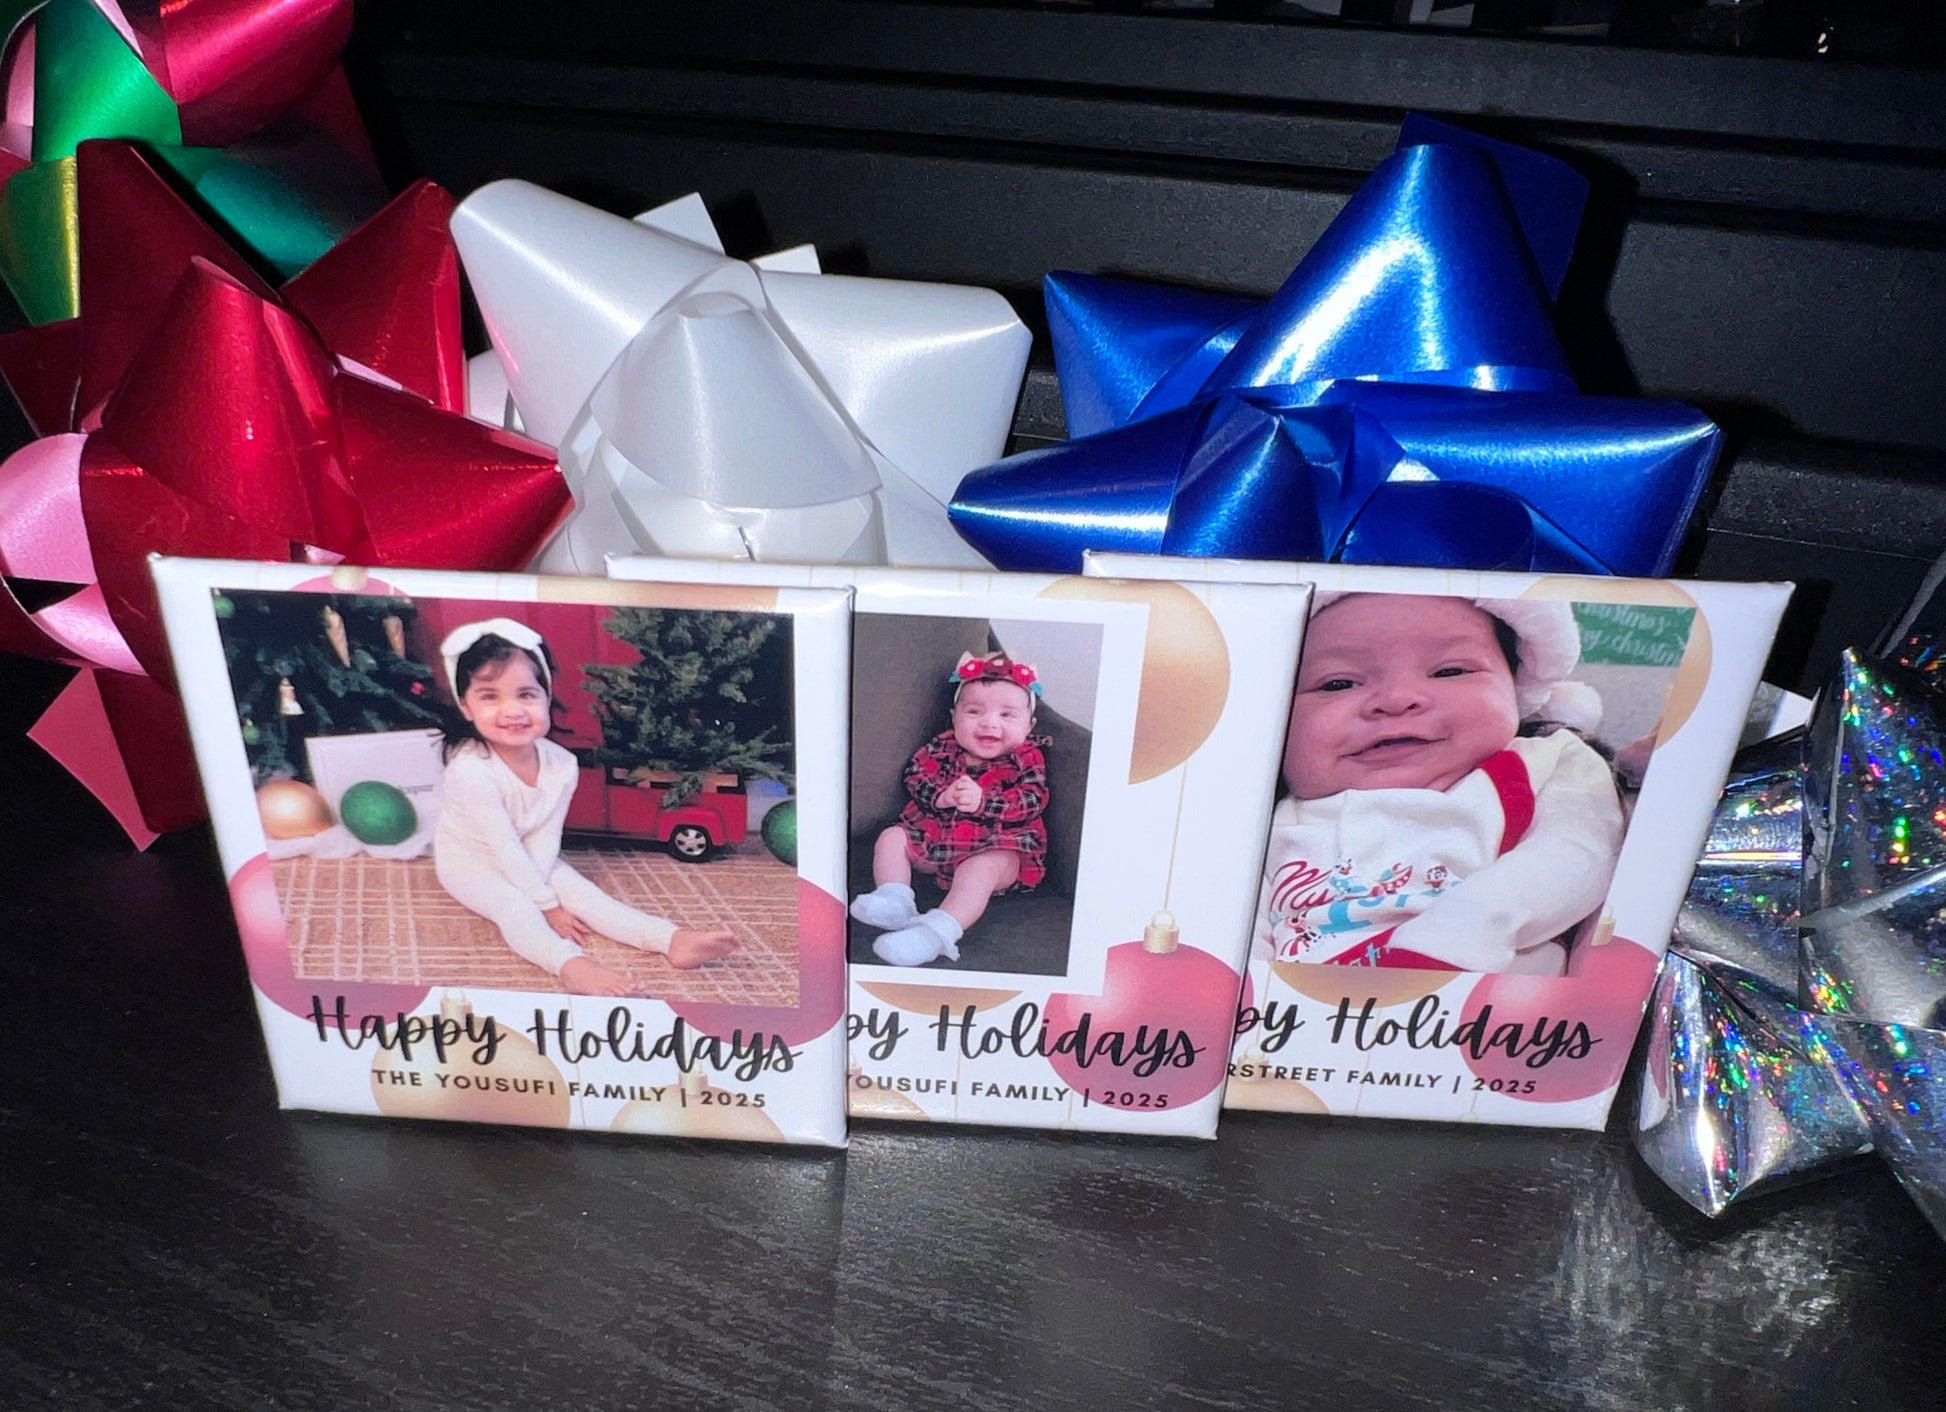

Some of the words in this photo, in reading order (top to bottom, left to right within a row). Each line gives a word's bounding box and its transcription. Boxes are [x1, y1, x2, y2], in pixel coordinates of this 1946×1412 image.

[307, 994, 506, 1064] Happy
[527, 1006, 803, 1082] Holidays
[929, 1002, 1206, 1078] Holidays
[1326, 994, 1603, 1069] Holidays
[371, 1068, 423, 1088] THE
[434, 1071, 557, 1097] YOUSUFI
[568, 1080, 667, 1103] FAMILY
[700, 1089, 767, 1109] 2025
[971, 1081, 1070, 1103] FAMILY
[1102, 1090, 1169, 1109] 2025
[1346, 1070, 1443, 1089] FAMILY
[1471, 1078, 1536, 1094] 2025
